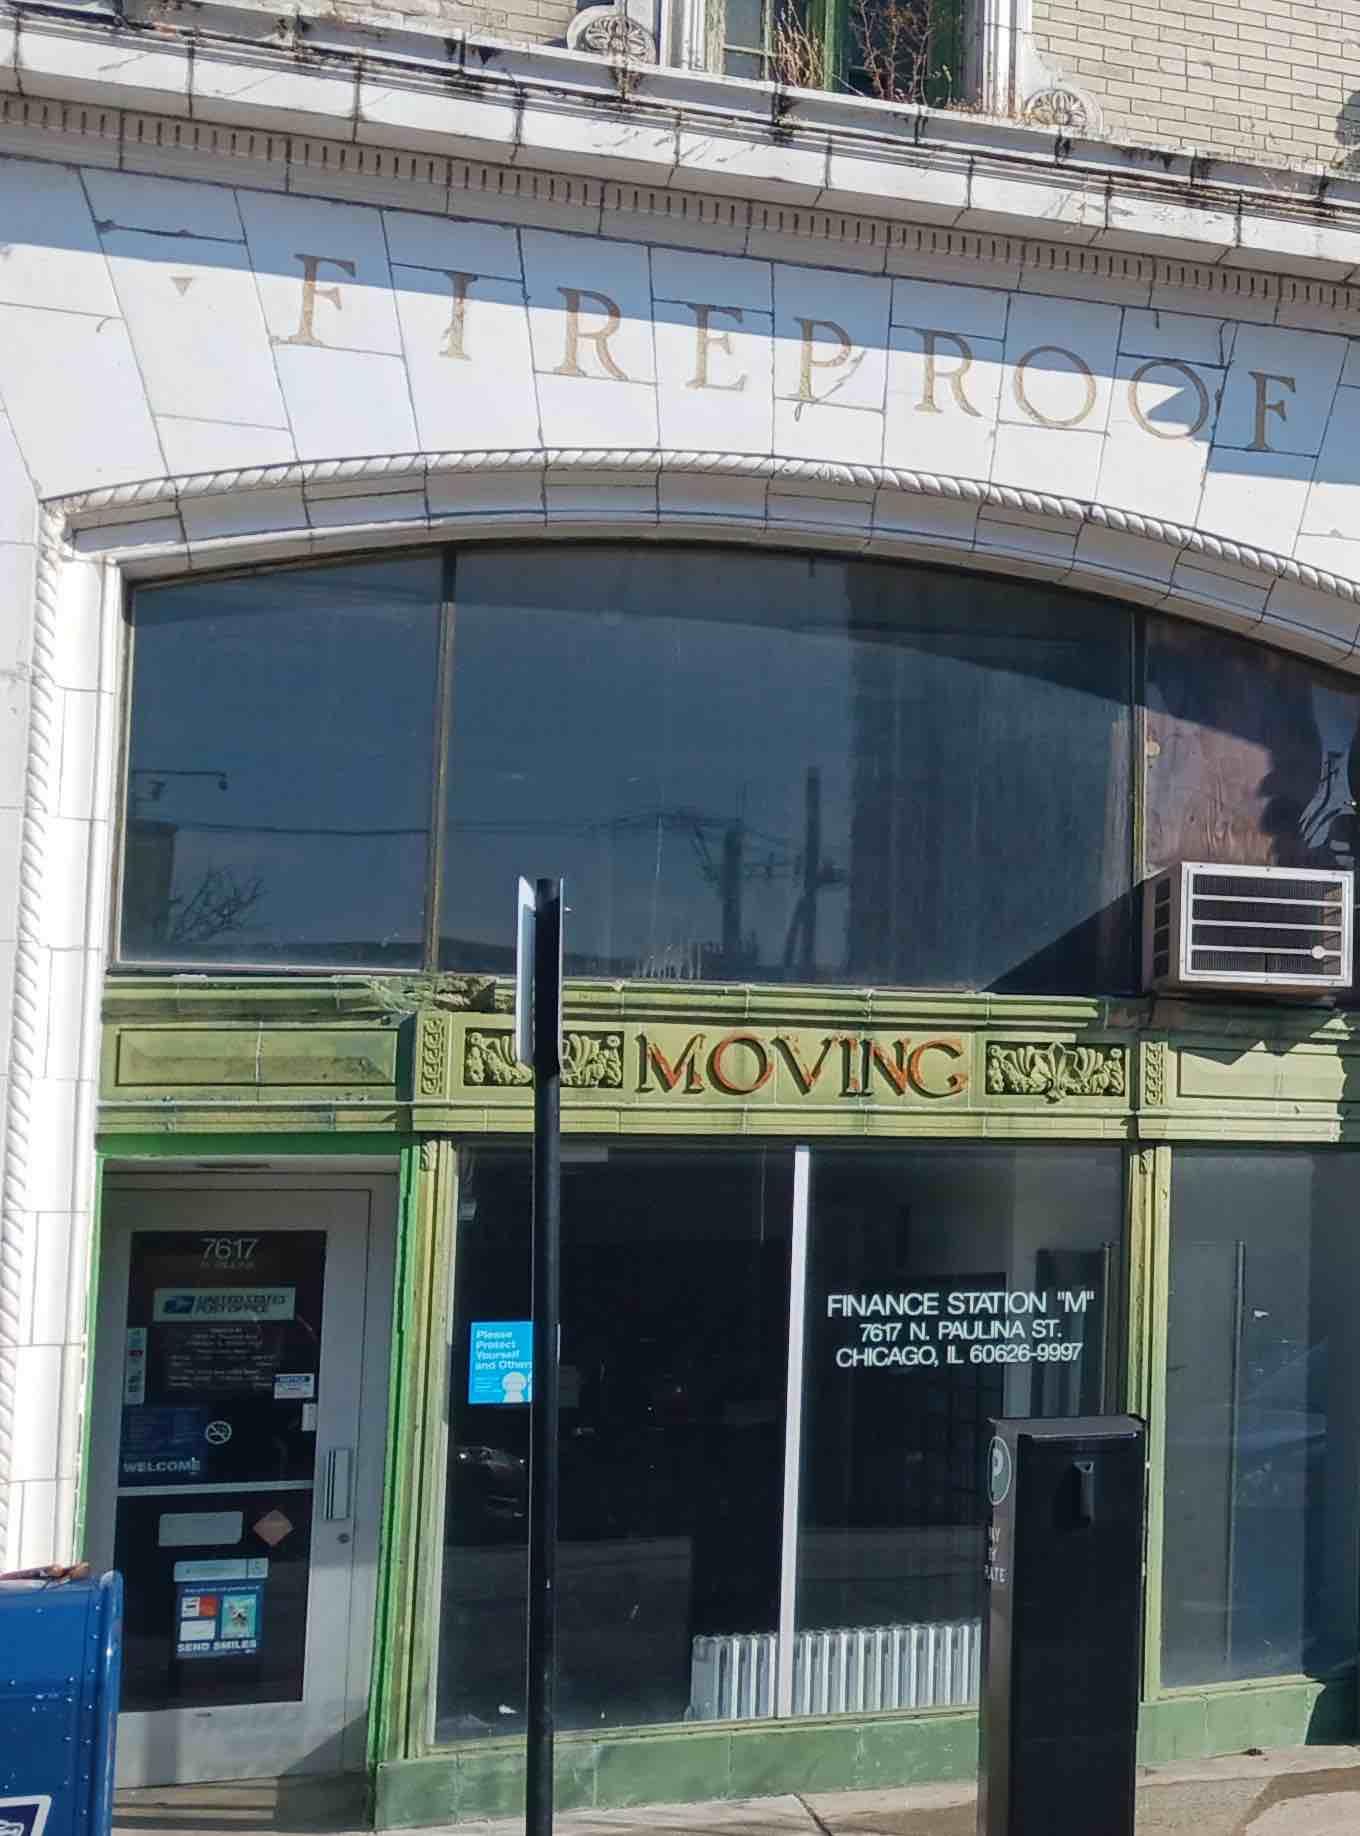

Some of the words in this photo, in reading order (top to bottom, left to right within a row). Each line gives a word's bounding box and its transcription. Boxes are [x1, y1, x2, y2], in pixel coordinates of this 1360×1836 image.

[276, 253, 1297, 453] FIREPROOF
[634, 1029, 971, 1098] MOVING
[201, 1238, 259, 1260] 7617
[827, 1293, 940, 1317] FINANCE
[946, 1291, 1047, 1315] STATION
[1057, 1291, 1095, 1313] "M"
[476, 1329, 512, 1339] Please
[859, 1322, 902, 1342] 7617
[909, 1322, 930, 1341] N.
[937, 1320, 1025, 1341] PAULINA
[1031, 1319, 1062, 1339] ST.
[476, 1340, 516, 1349] Protect
[476, 1350, 520, 1360] Yourself
[836, 1346, 940, 1368] CHICAGO,
[946, 1345, 965, 1364] IL
[969, 1342, 1084, 1363] 60626-9997
[475, 1360, 496, 1370] and
[123, 1460, 200, 1473] WELCOME
